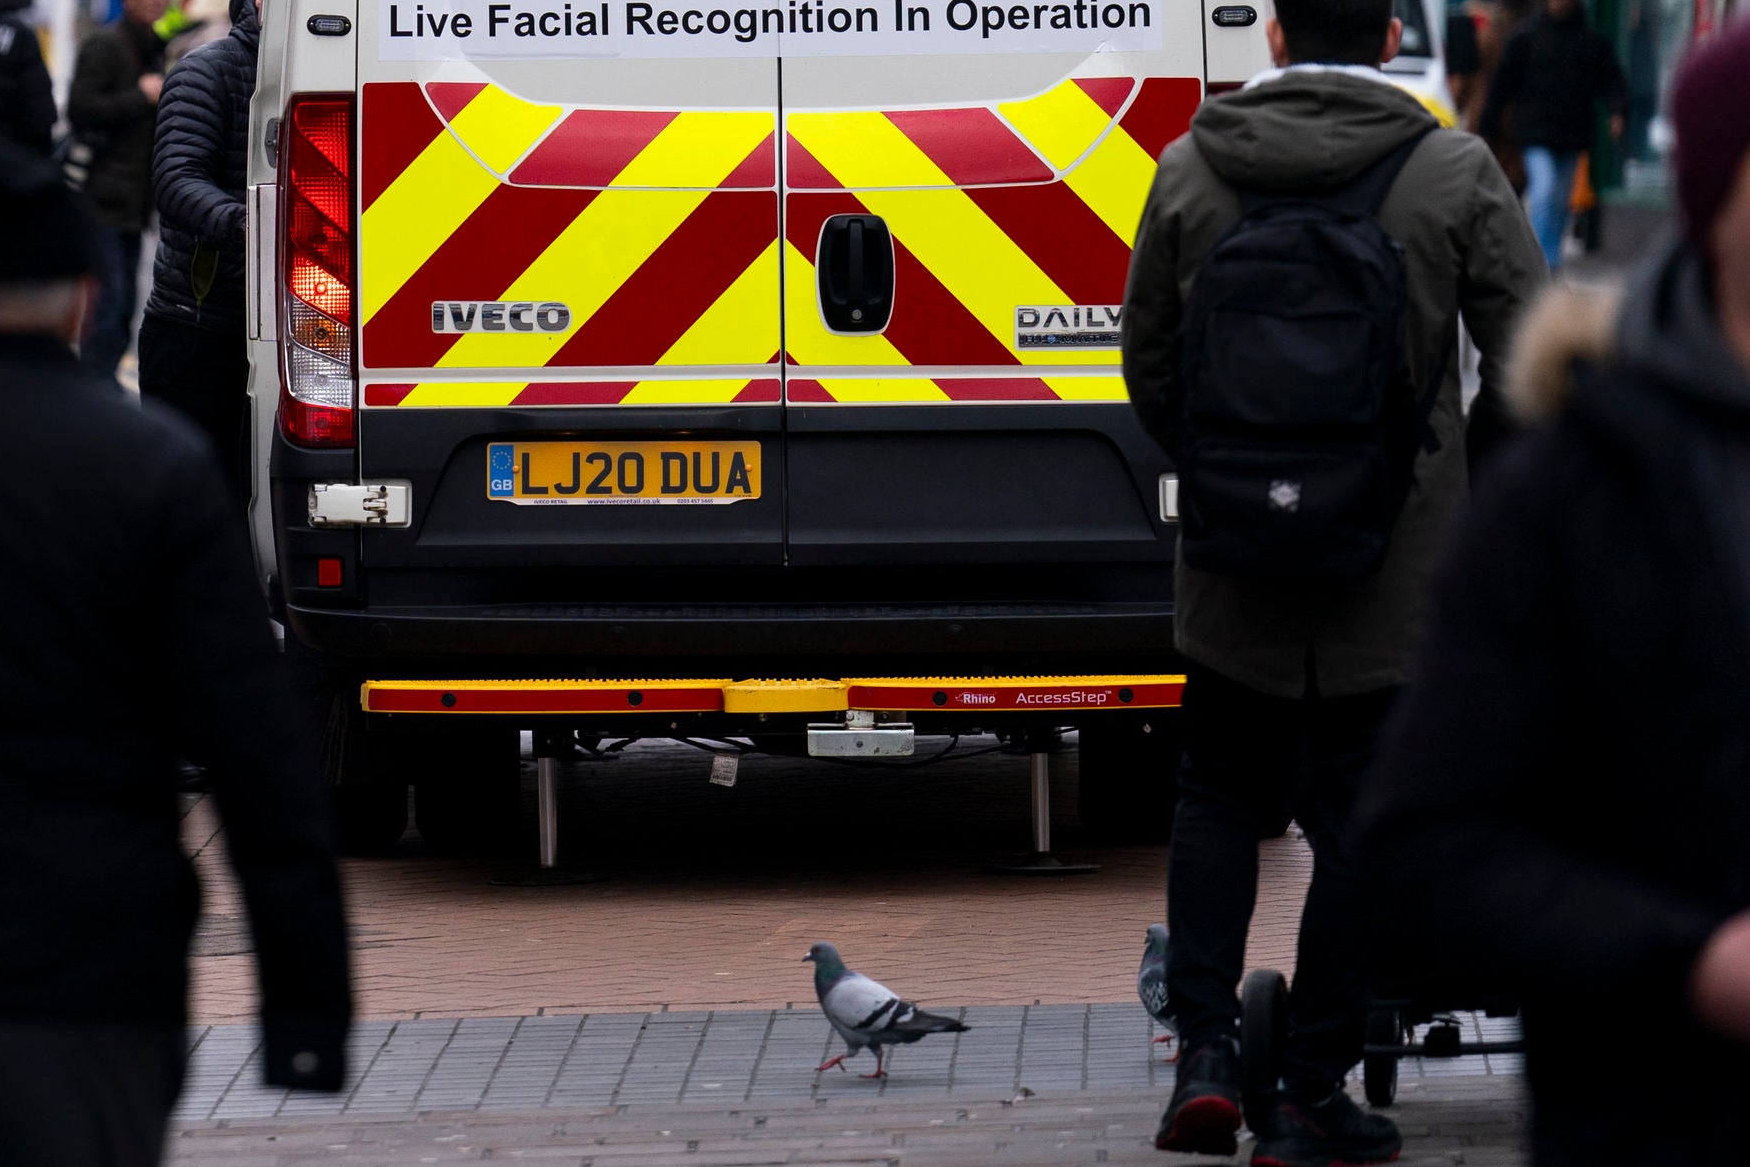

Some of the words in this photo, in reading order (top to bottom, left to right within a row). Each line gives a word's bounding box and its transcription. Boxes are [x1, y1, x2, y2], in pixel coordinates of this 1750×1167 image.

[390, 3, 473, 38] Live
[488, 2, 610, 38] Facial
[626, 0, 879, 43] Recognition
[433, 302, 570, 331] IVECO
[1018, 307, 1122, 328] DAILY
[491, 479, 512, 491] GB
[521, 452, 644, 495] LJ20
[661, 451, 752, 494] DUA
[962, 692, 996, 704] Rhino
